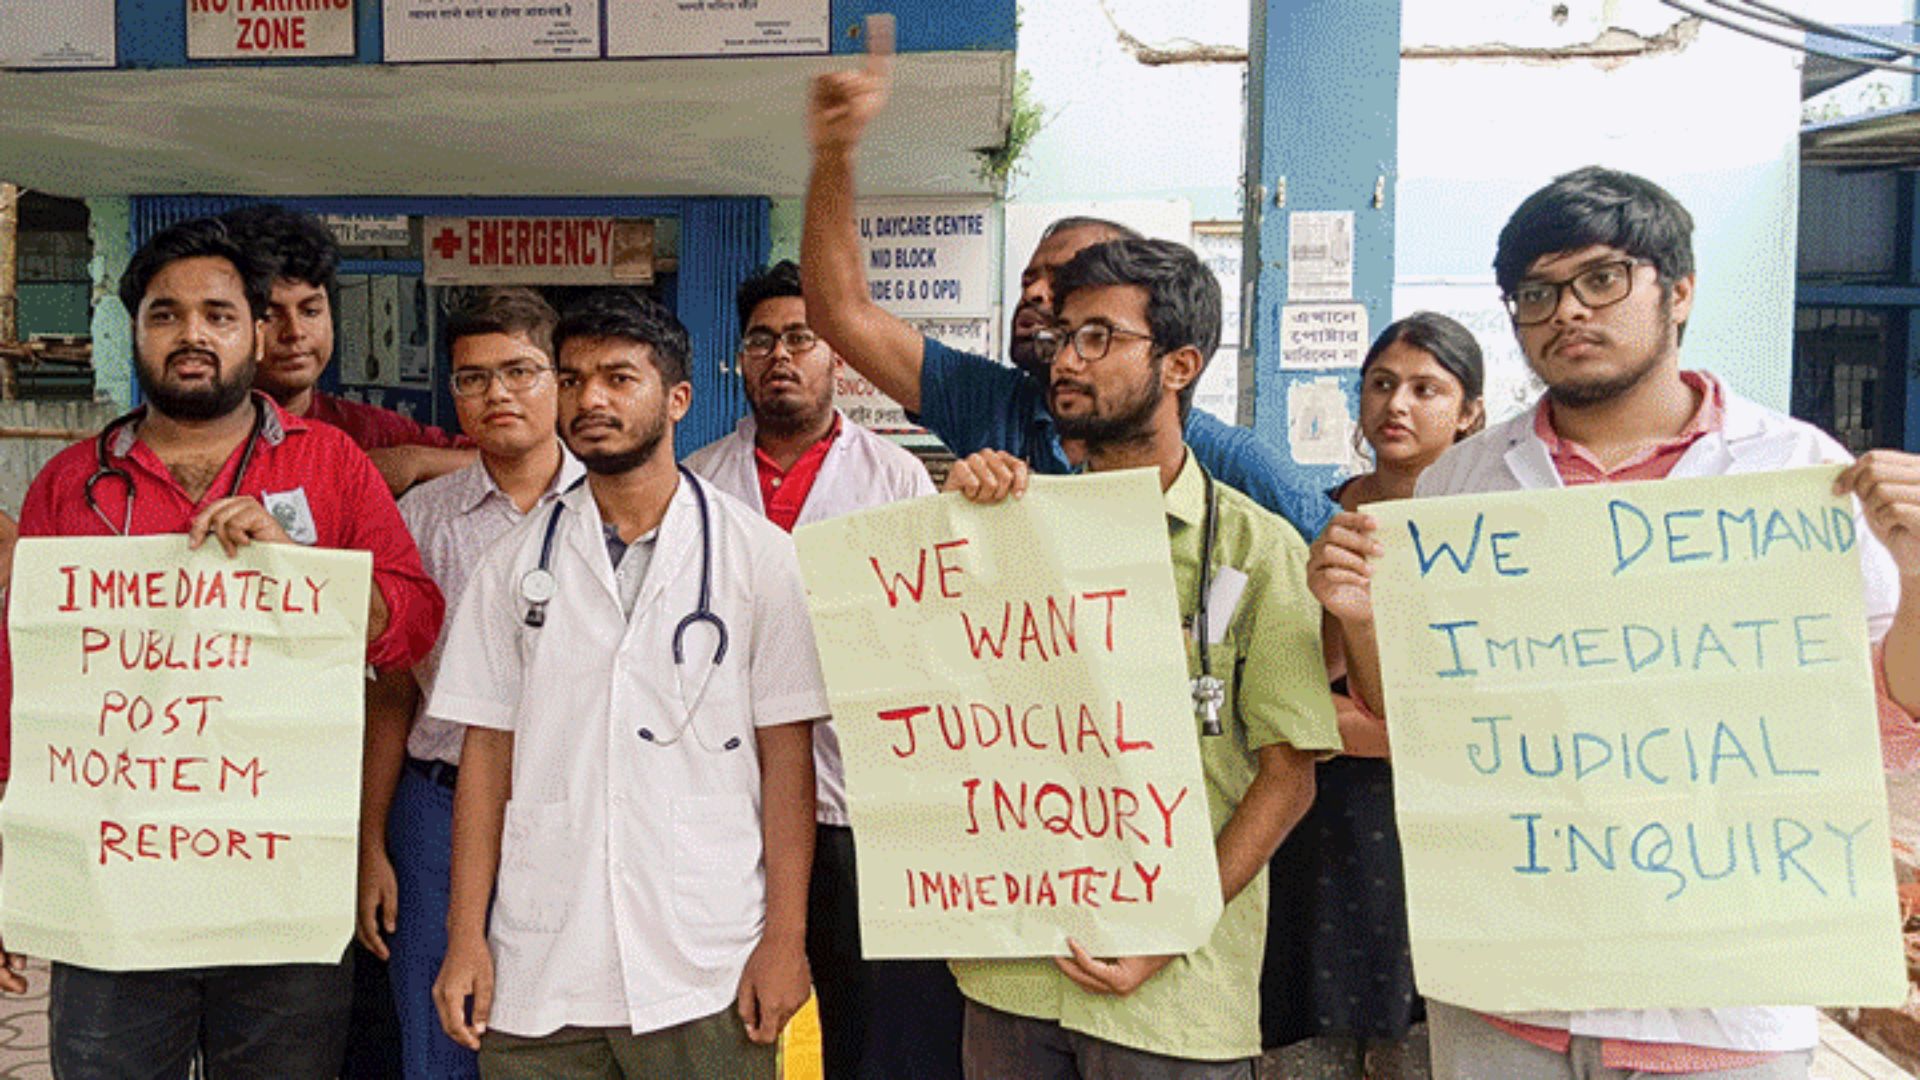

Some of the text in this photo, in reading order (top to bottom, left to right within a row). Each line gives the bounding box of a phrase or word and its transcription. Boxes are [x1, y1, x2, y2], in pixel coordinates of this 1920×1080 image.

[236, 18, 306, 50] ZONE
[468, 220, 614, 266] EMERGENCY
[859, 214, 984, 241] U, DAYCARE CENTRE
[895, 247, 937, 269] BLOCK
[895, 280, 905, 300] G
[907, 280, 916, 300] &
[920, 280, 929, 300] O
[1607, 499, 1858, 577] DEMAND
[58, 565, 329, 615] IMMEDIATELY
[869, 538, 970, 609] WE
[961, 588, 1128, 662] WANT
[1429, 614, 1842, 679] IMMEDIATE
[82, 627, 252, 675] PUBLISH
[98, 690, 223, 736] POST
[877, 701, 1155, 760] JUDICIAL
[48, 744, 269, 798] MORTEM
[1466, 715, 1821, 786] JUDICIAL
[962, 778, 1189, 849] INQURY
[99, 820, 291, 866] REPORT
[906, 861, 1162, 912] IMMEDIATELY
